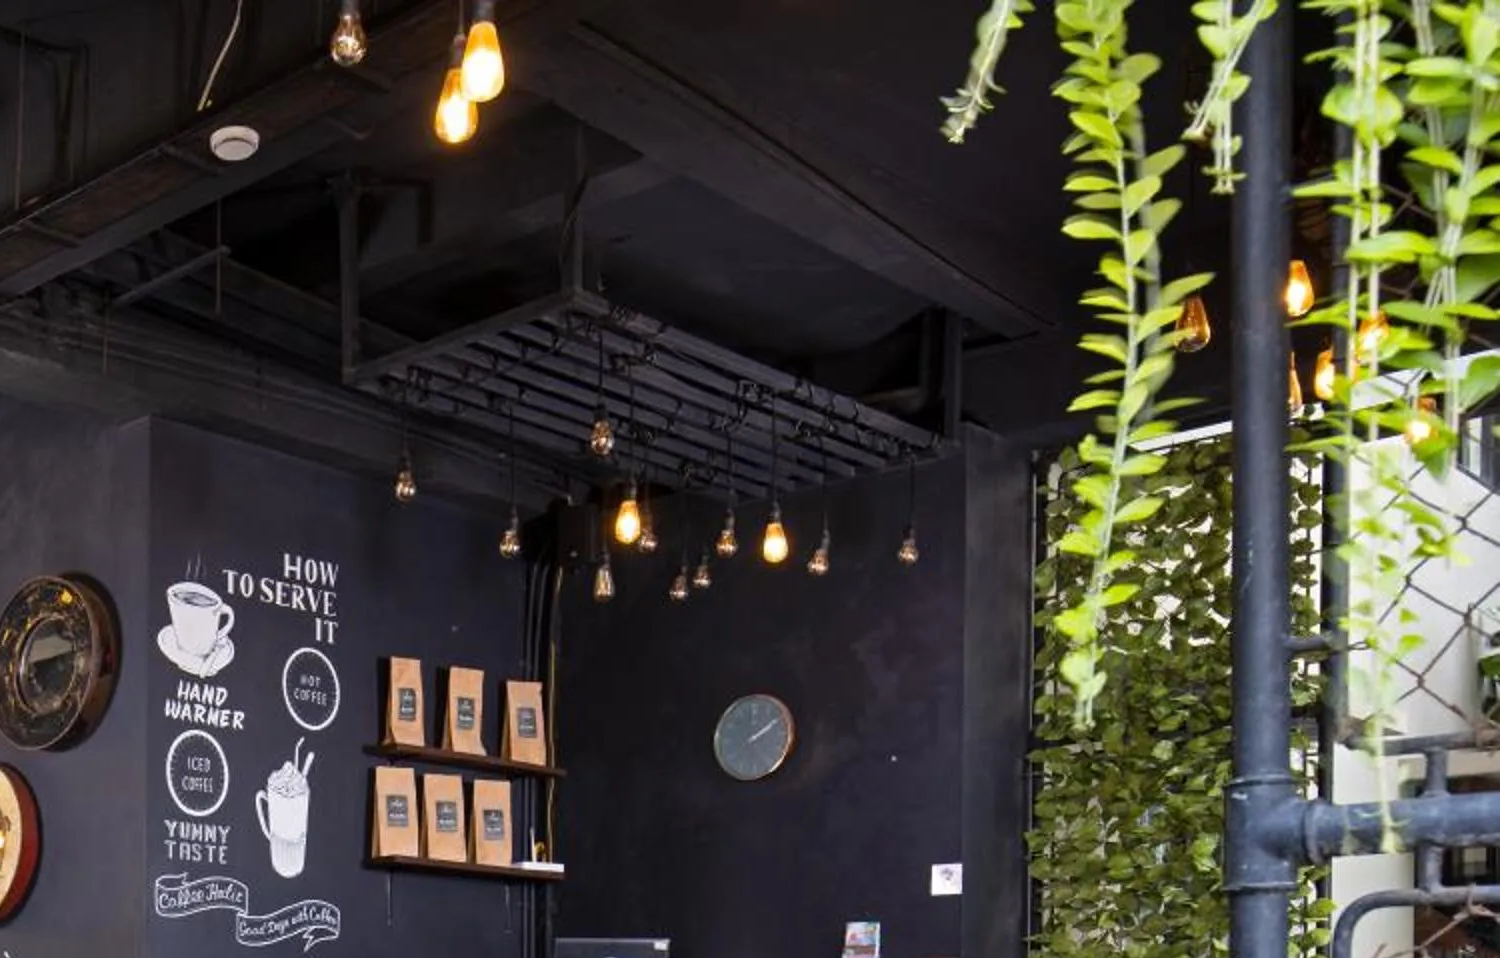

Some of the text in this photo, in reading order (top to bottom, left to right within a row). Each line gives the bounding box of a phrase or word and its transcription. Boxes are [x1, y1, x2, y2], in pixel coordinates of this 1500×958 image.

[283, 552, 340, 588] HOW
[222, 568, 338, 618] TO SERVE
[314, 616, 339, 645] IT
[177, 678, 229, 708] HAND
[163, 839, 229, 866] TASTE
